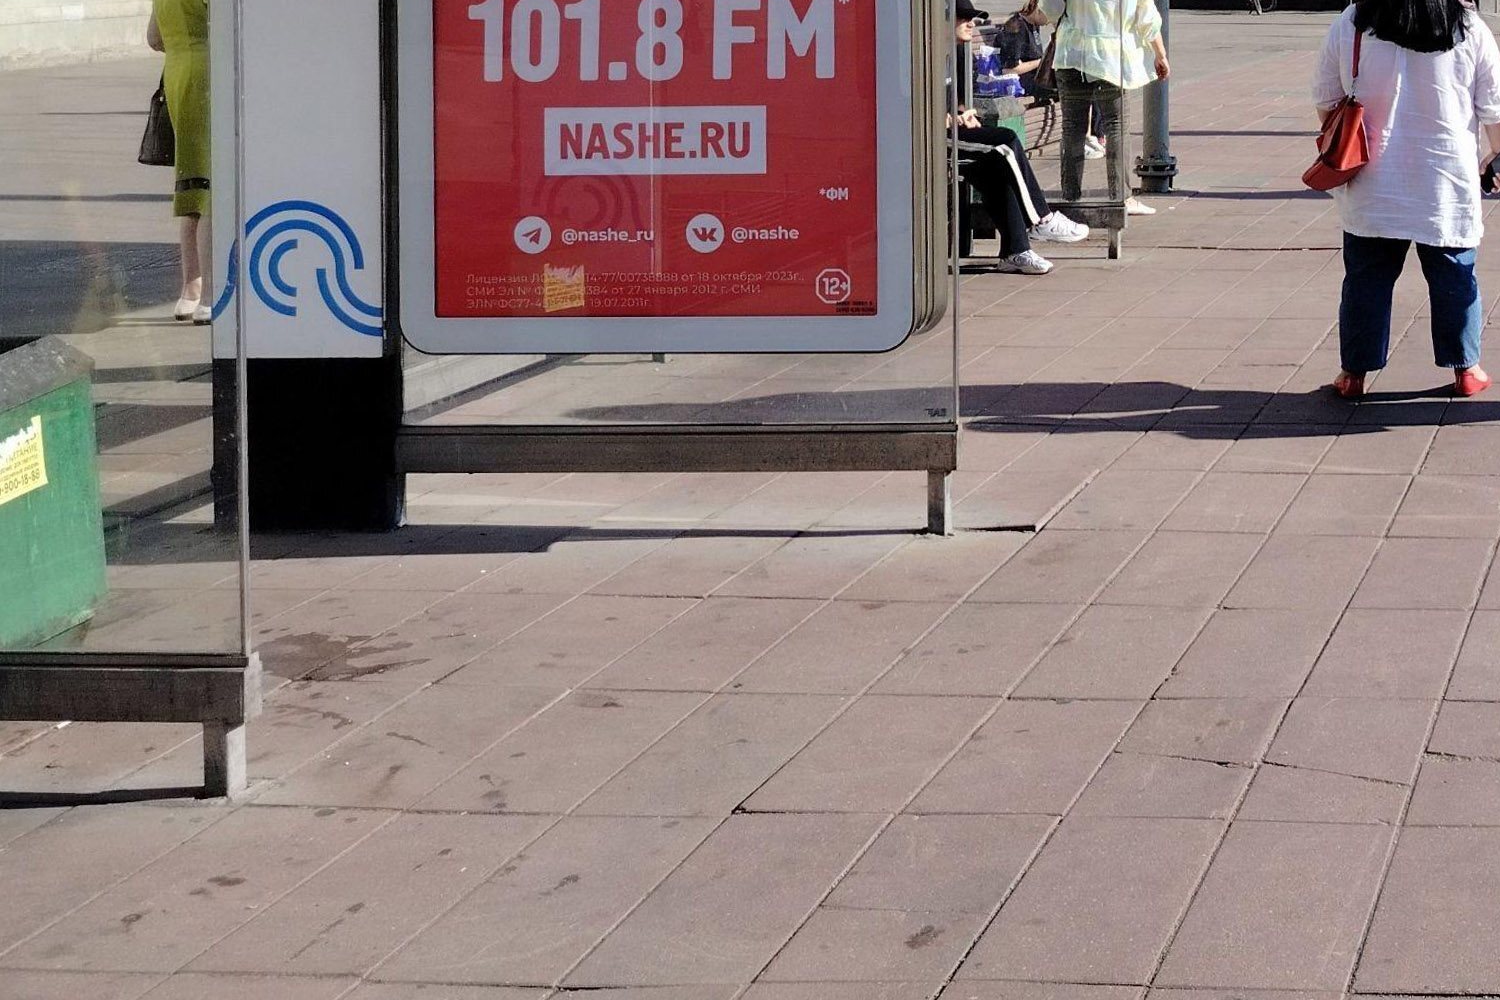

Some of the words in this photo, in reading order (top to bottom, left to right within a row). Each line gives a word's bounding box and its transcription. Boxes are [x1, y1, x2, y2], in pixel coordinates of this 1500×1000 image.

[559, 120, 751, 160] NASHE.RU
[561, 228, 654, 244] @nashe_ru
[731, 226, 800, 242] @nashe
[713, 270, 762, 283] октября
[466, 287, 495, 296] СМИ
[611, 287, 623, 295] от
[627, 285, 641, 295] 27
[644, 286, 689, 298] января
[692, 284, 717, 294] 2012
[731, 284, 761, 294] СМИ
[821, 276, 849, 296] 12+
